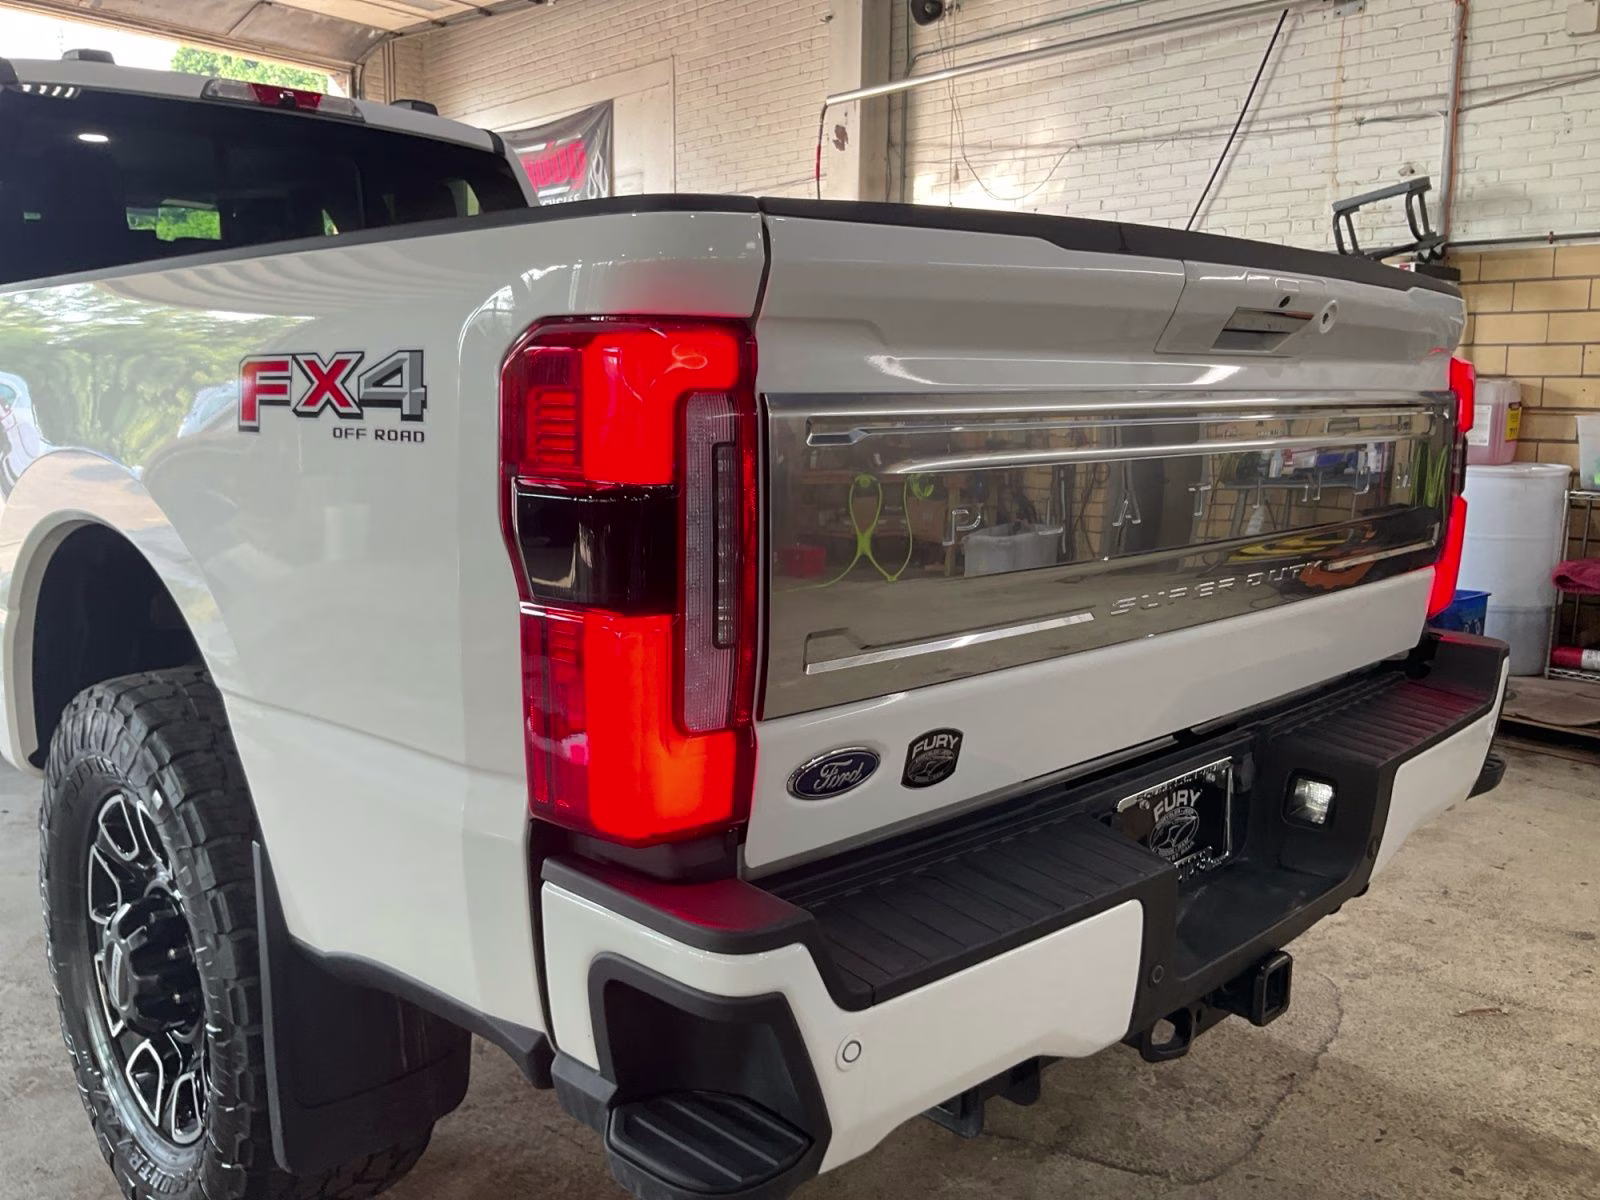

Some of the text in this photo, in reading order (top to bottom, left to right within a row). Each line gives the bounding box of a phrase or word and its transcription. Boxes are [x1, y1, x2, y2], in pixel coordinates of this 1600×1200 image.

[238, 349, 427, 432] FX4
[332, 427, 425, 443] OFF ROAD
[911, 733, 960, 759] FURY
[813, 758, 866, 792] Ford
[1153, 788, 1202, 823] FURY
